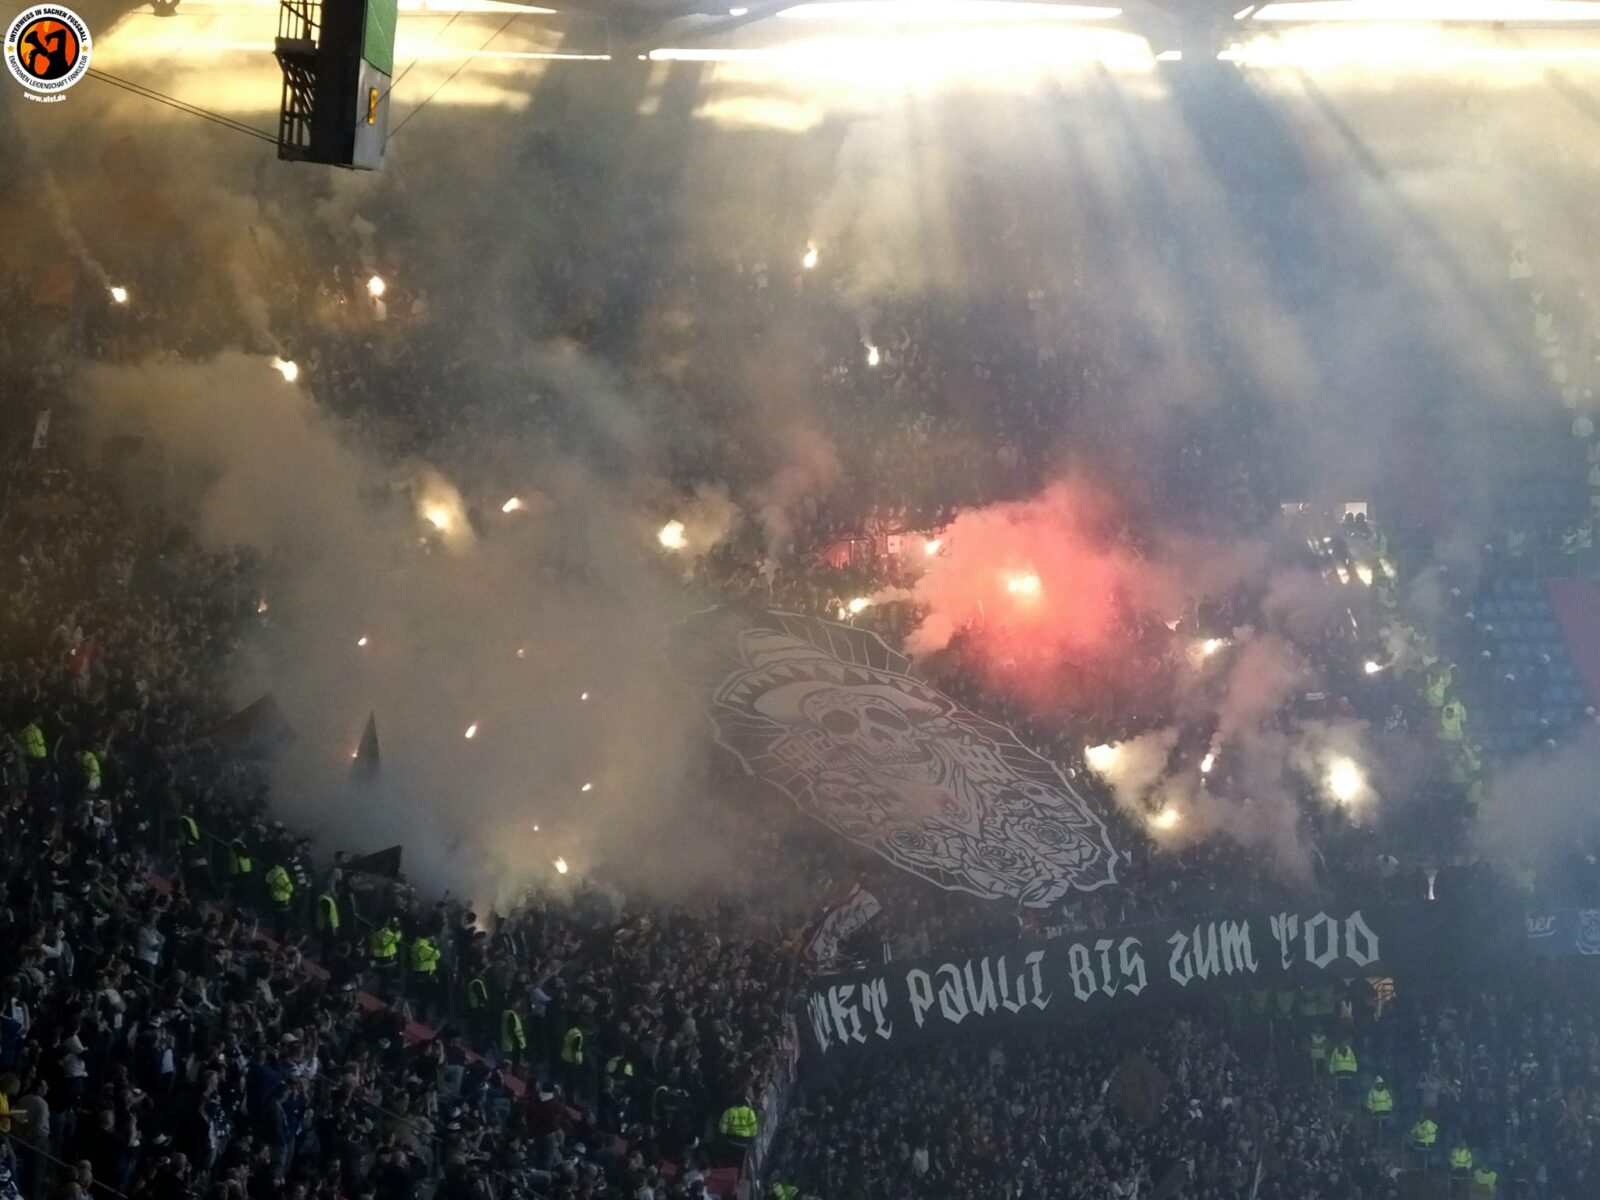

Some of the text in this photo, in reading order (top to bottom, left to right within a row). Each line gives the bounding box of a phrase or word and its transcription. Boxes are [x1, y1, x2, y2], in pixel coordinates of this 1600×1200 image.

[906, 950, 1052, 1029] PAULI
[1068, 937, 1148, 1002] BIS
[1166, 919, 1259, 987] ZUM
[1270, 910, 1380, 970] TOD
